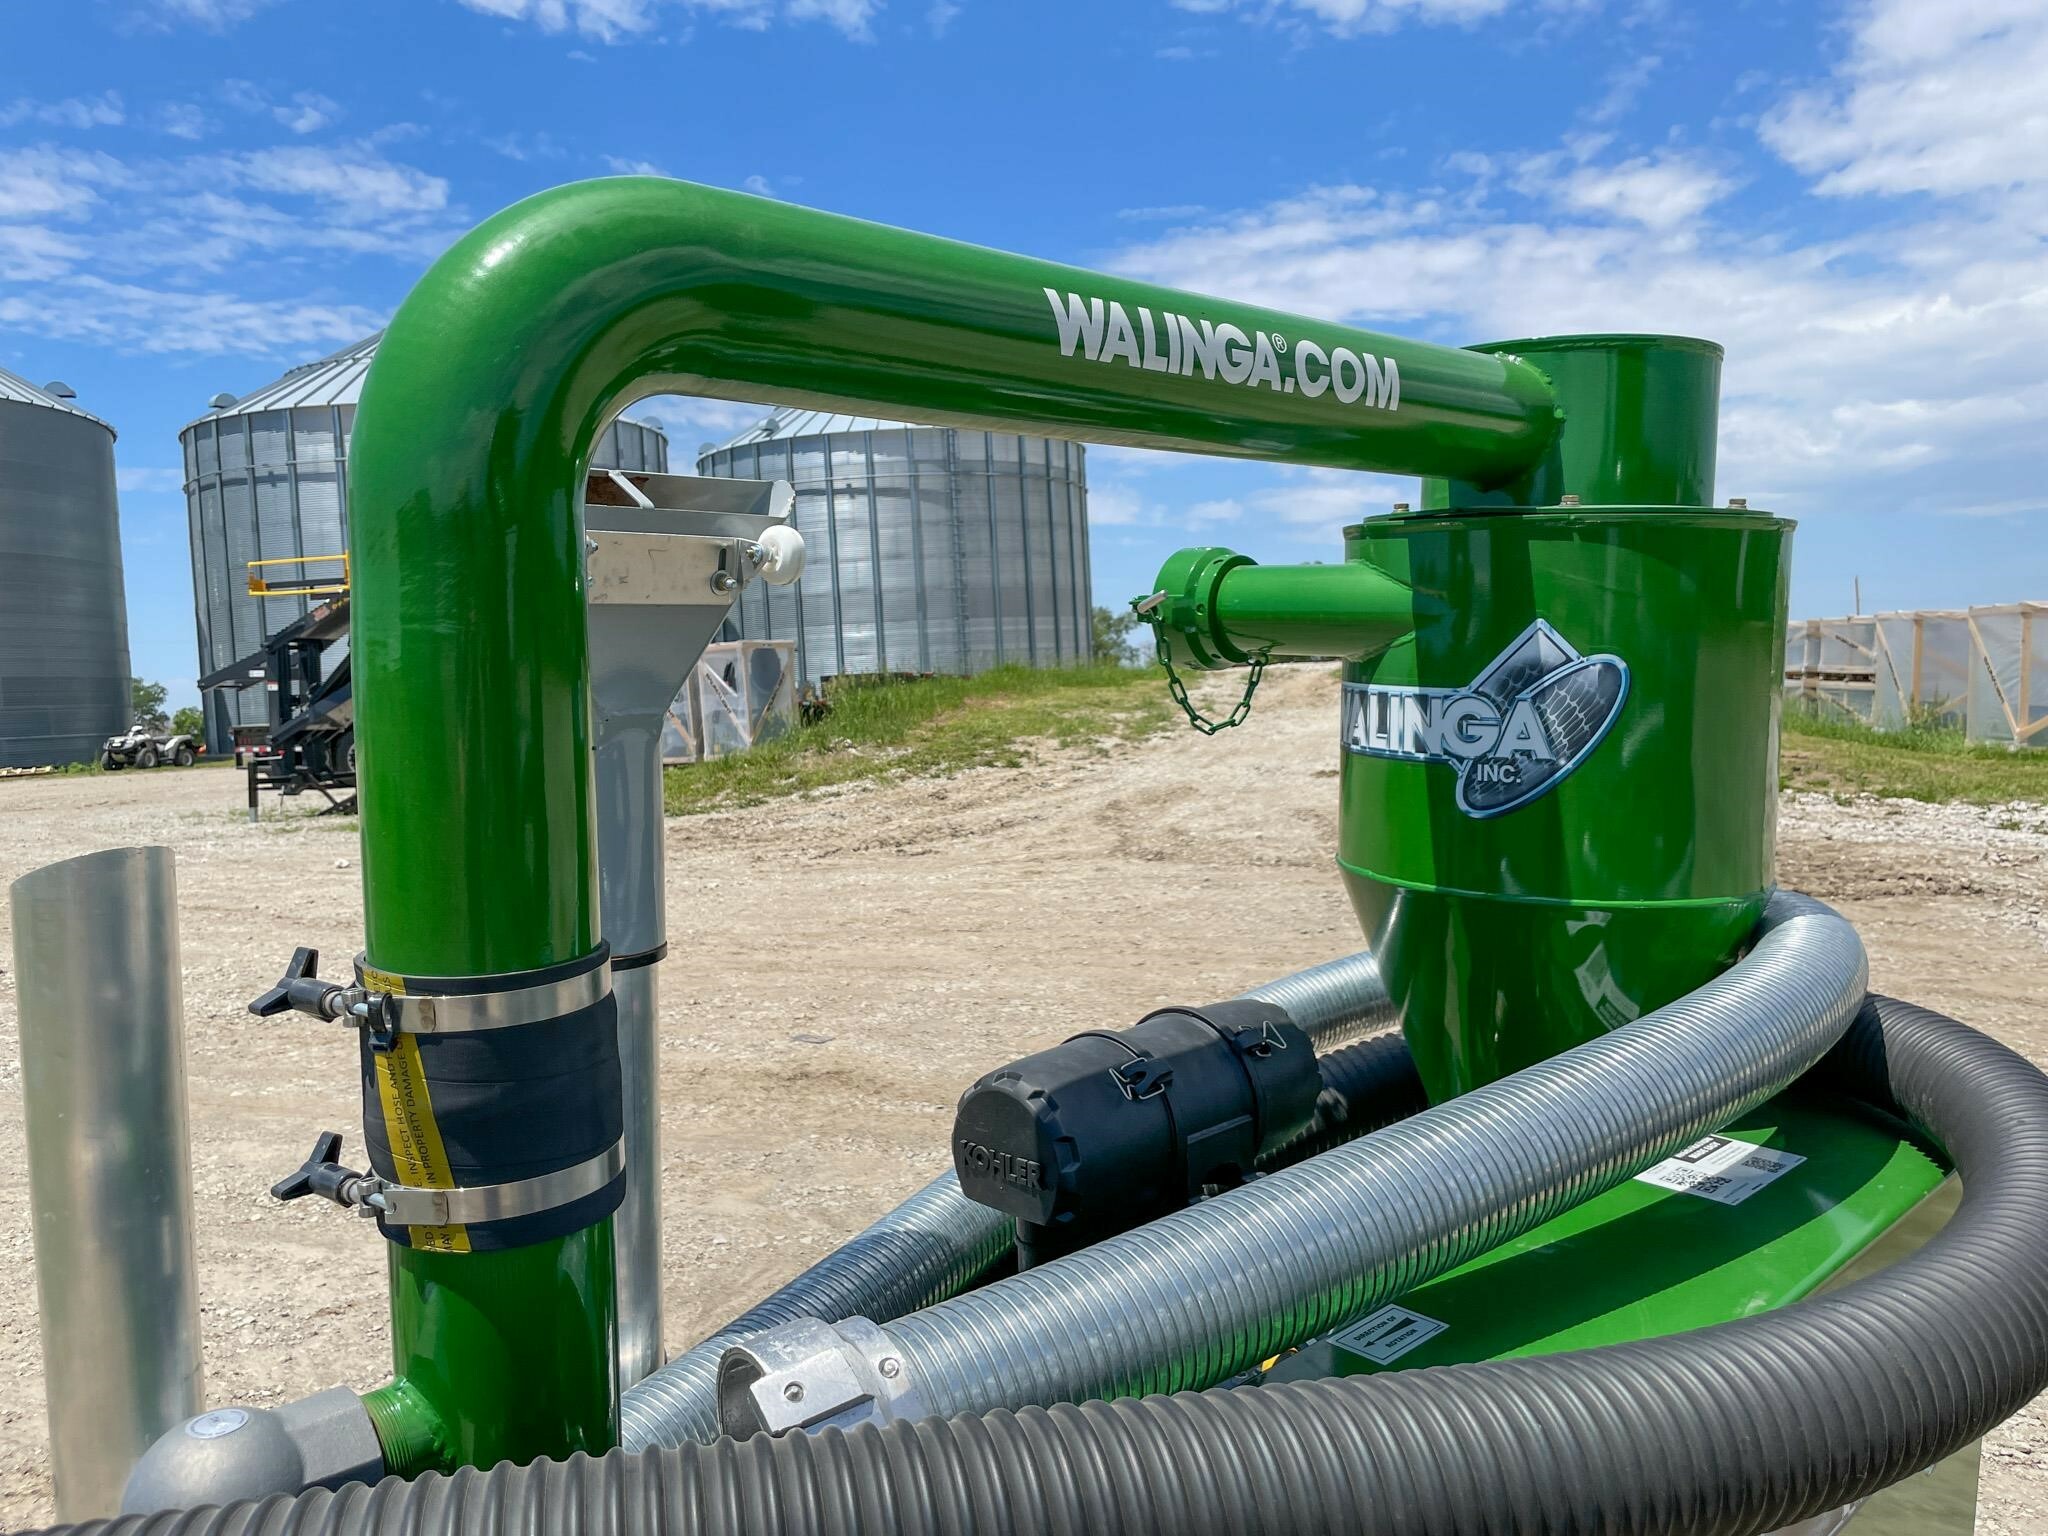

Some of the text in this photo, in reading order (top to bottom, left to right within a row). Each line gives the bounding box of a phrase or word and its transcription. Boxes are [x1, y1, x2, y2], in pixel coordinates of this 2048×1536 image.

[1343, 690, 1556, 760] ALINGA
[1476, 763, 1521, 784] INC.
[387, 1063, 398, 1089] AND
[398, 1054, 416, 1107] DAMAGE
[392, 1093, 404, 1125] HOSE
[399, 1129, 418, 1175] INSPECT
[409, 1111, 432, 1169] PROPERTY
[425, 1168, 437, 1184] IN
[960, 1139, 1041, 1192] KOHLER
[1353, 1315, 1397, 1341] DIRECTION OF
[1385, 1328, 1419, 1348] ROTATION
